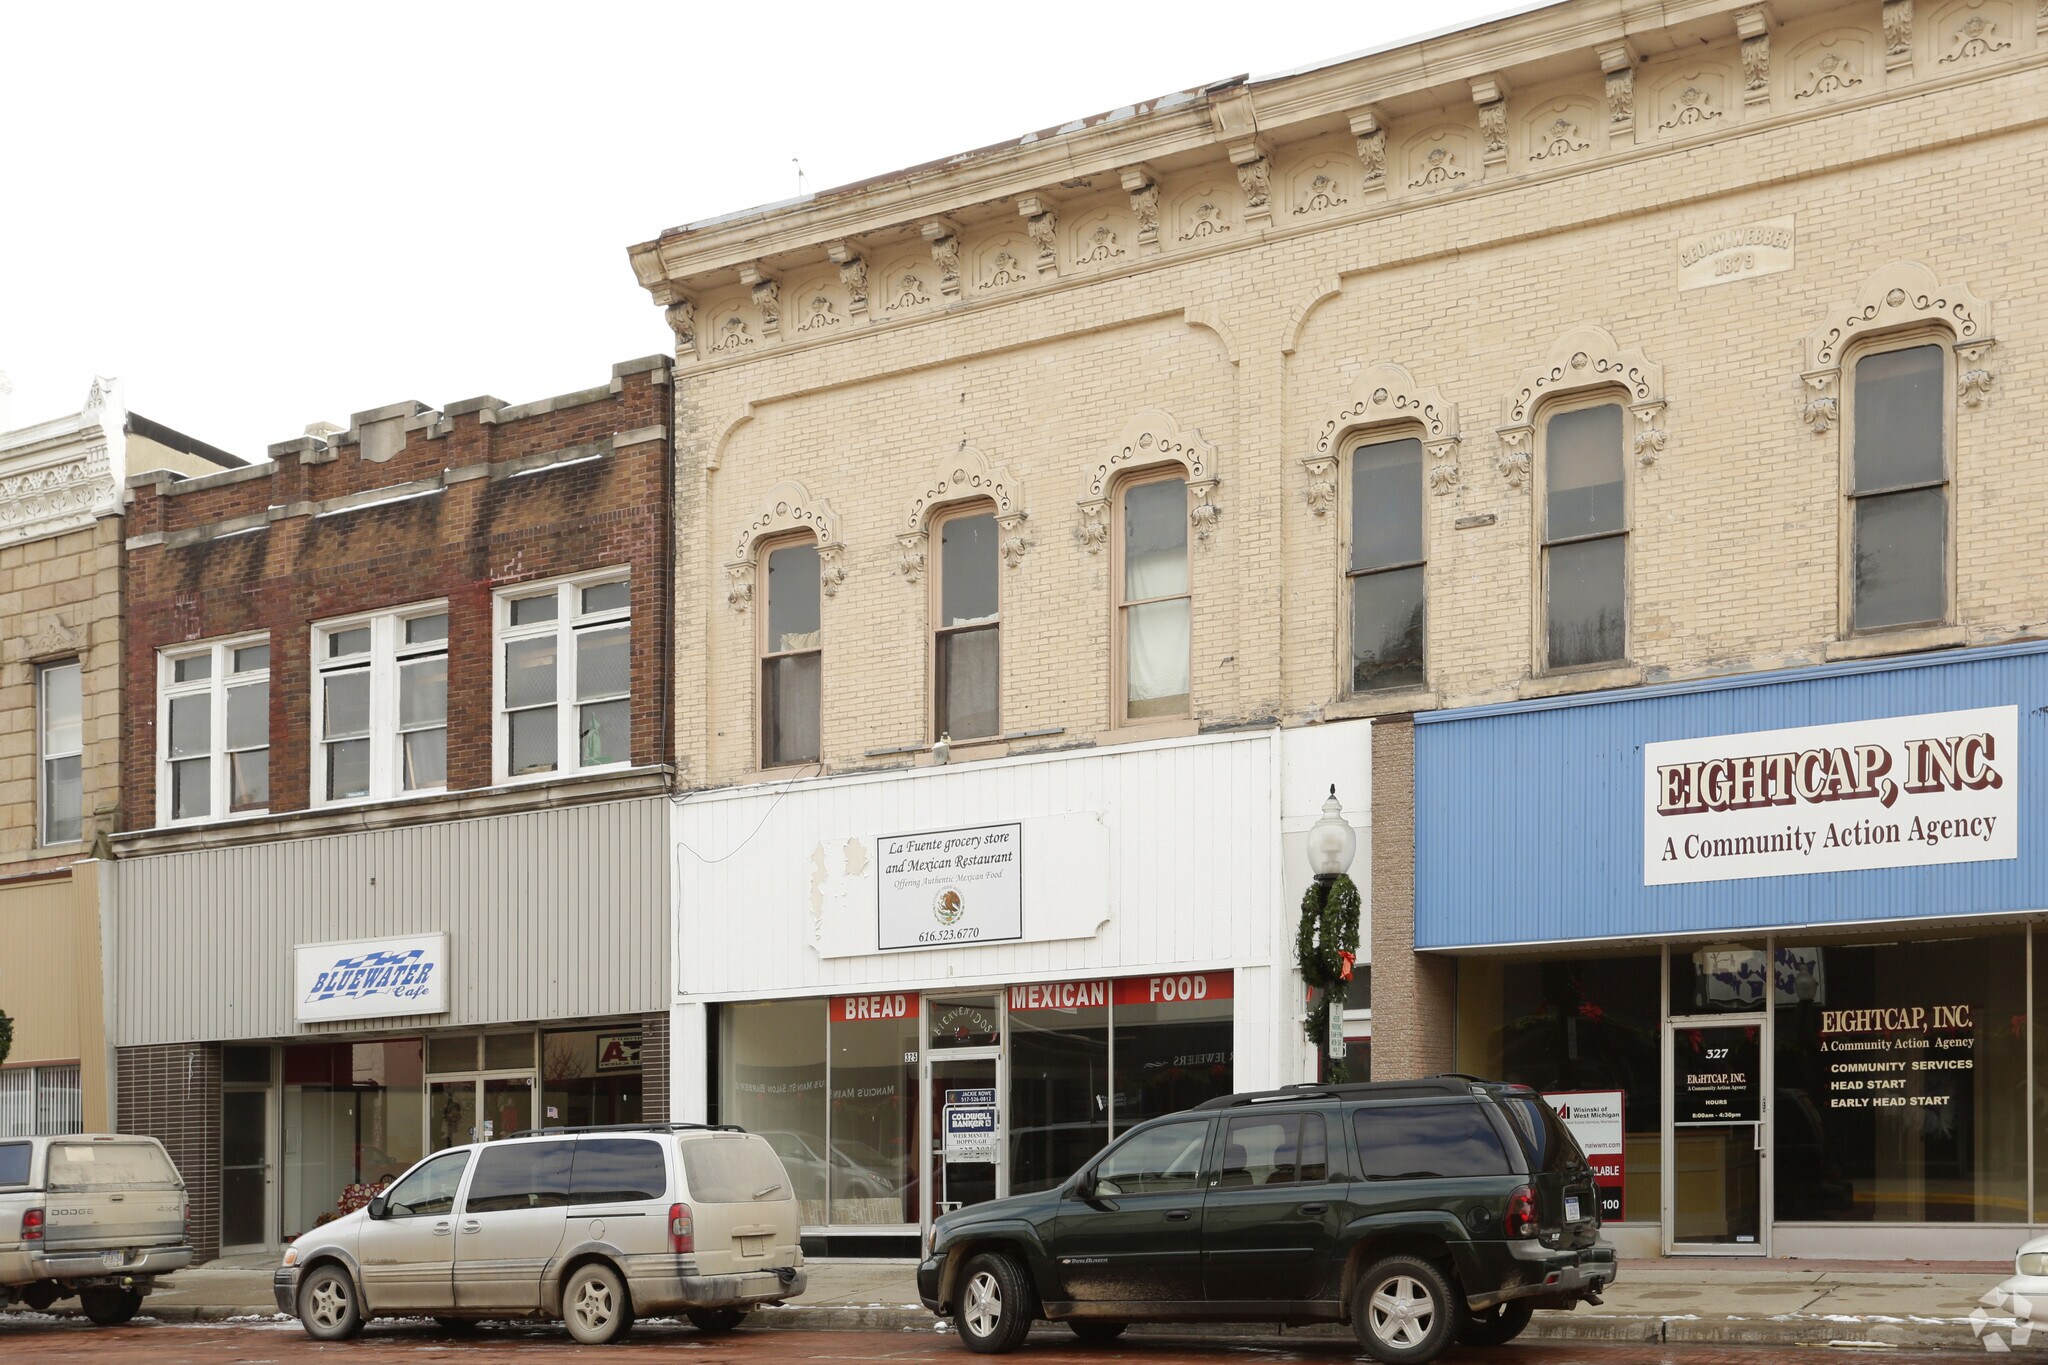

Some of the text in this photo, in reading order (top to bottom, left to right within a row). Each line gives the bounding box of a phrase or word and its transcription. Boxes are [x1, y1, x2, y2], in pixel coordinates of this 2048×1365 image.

[1714, 253, 1755, 277] 1879
[1657, 733, 2003, 816] EIGHTCAP, INC.
[888, 832, 1010, 855] La Fuente grocery store
[1661, 815, 1997, 861] A Community Action Agency
[885, 851, 1013, 874] and Mexican Restaurant
[893, 869, 1004, 890] Offering Authentic Mexican Food
[918, 927, 980, 942] 616.523.6770
[310, 962, 434, 994] BLUEWATER
[393, 985, 430, 1000] Cafe
[1011, 982, 1104, 1009] MEXICAN
[1150, 975, 1207, 1002] FOOD
[845, 995, 907, 1020] BREAD
[934, 1006, 993, 1037] BIENVENIDOS
[1821, 1005, 1973, 1034] EIGHTCAP, INC.
[1705, 1048, 1729, 1059] 327
[1820, 1037, 1975, 1052] A Community Action Agency
[905, 1052, 917, 1062] 325
[1830, 1059, 1974, 1073] COMMUNITY SERVICES
[1687, 1073, 1746, 1084] EIGHTCAP, INC.
[1830, 1079, 1907, 1090] HEAD START
[1830, 1096, 1950, 1108] EARLY HEAD START
[951, 1112, 992, 1120] COLDWELL
[952, 1120, 984, 1128] BANKER
[51, 1208, 95, 1216] DODGE
